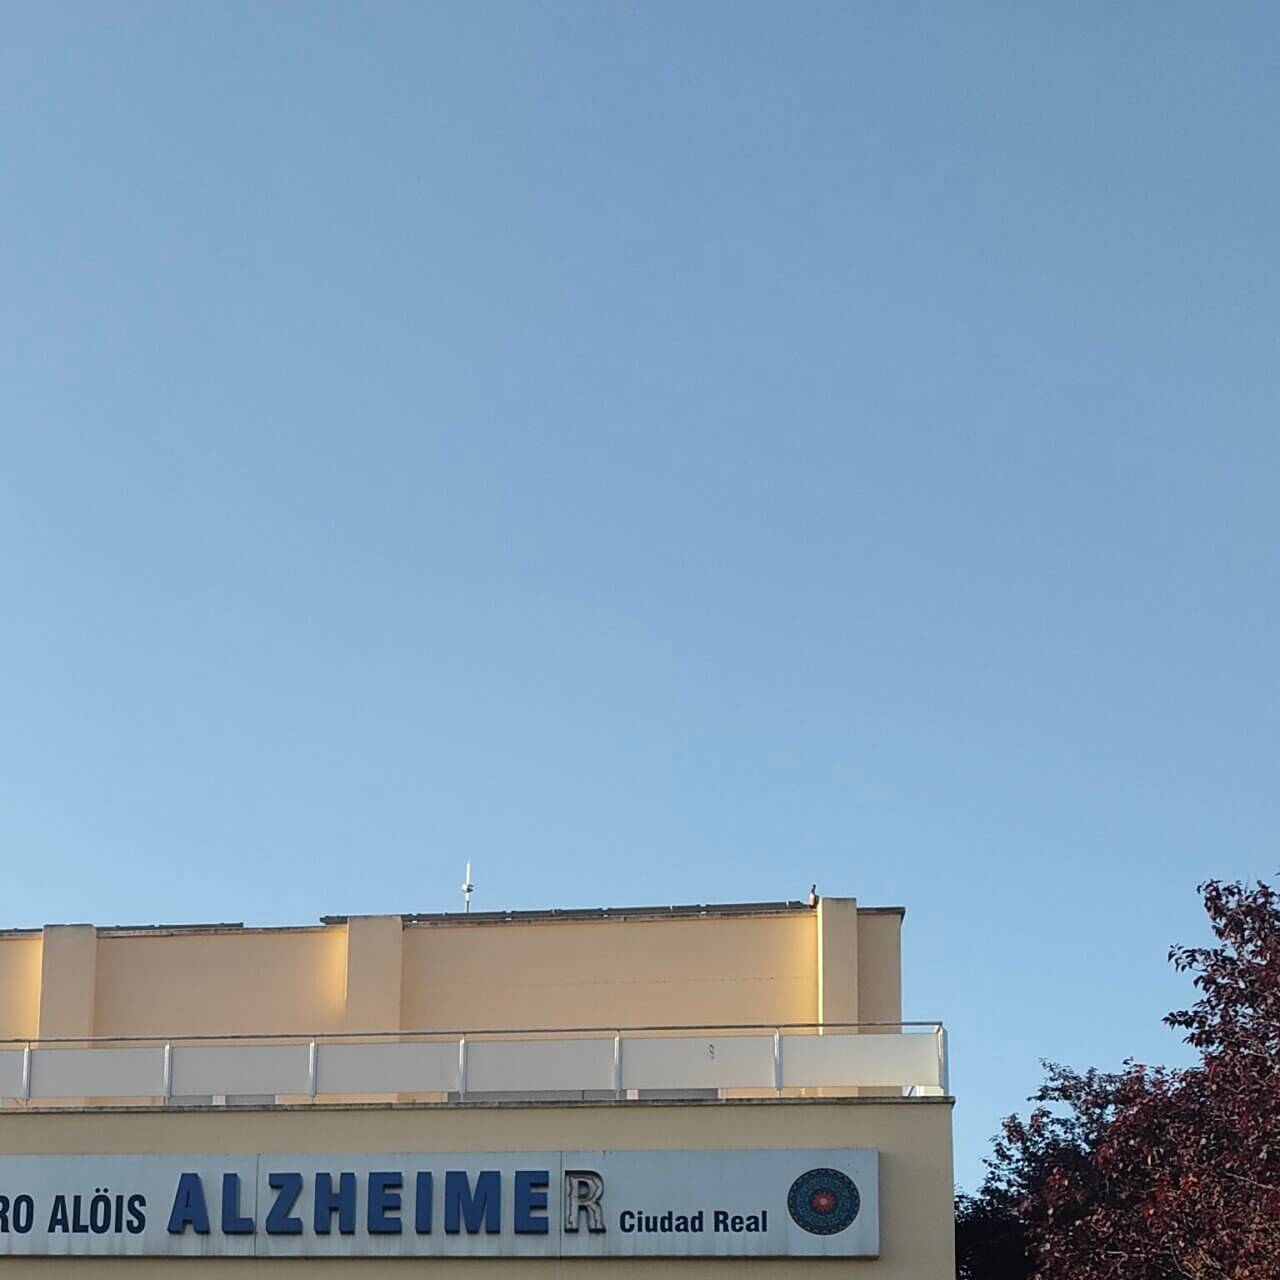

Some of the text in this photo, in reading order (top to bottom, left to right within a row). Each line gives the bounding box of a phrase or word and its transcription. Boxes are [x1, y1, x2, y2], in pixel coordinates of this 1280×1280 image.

[48, 1187, 147, 1235] ALÖIS
[167, 1169, 606, 1235] ALZHEIMER
[620, 1209, 768, 1234] Ciudad Real
